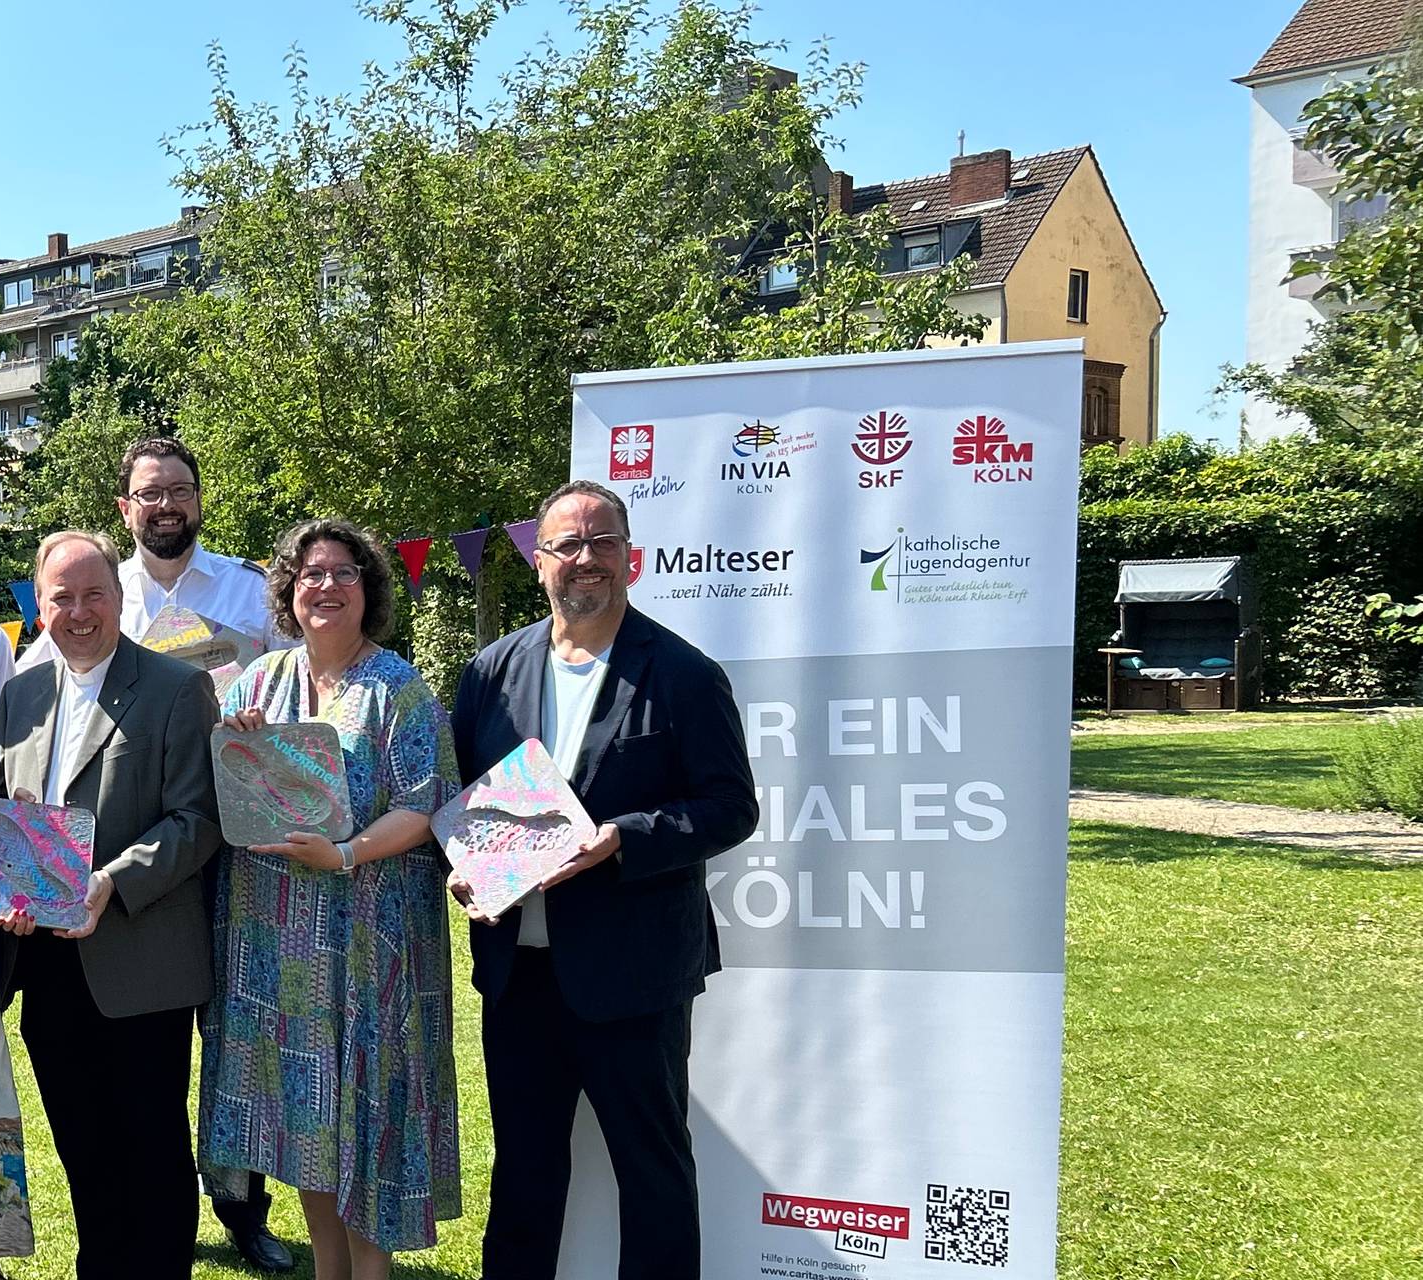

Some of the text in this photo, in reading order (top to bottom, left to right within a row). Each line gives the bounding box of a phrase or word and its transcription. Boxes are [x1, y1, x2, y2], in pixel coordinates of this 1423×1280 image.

[953, 443, 1033, 465] SKM
[612, 468, 649, 480] caritas
[721, 461, 791, 480] IN VIA
[858, 470, 903, 489] SkF
[974, 465, 1032, 483] KÖLN
[627, 483, 649, 508] für
[737, 484, 773, 494] KÖLN
[905, 534, 1000, 551] katholische
[655, 544, 793, 574] Malteser
[905, 552, 1030, 574] jugendagentur
[707, 584, 746, 599] Nähe
[751, 582, 793, 597] zählt.
[905, 580, 1013, 593] Gutes verlässlich tun
[905, 589, 1027, 604] in Köln und Rhein-Erft
[828, 696, 961, 756] EIN
[745, 781, 1008, 842] IALES
[766, 1198, 906, 1232] Wegweiser
[842, 1234, 880, 1252] Köln
[761, 1253, 866, 1272] Hilfe in Köln gesucht?
